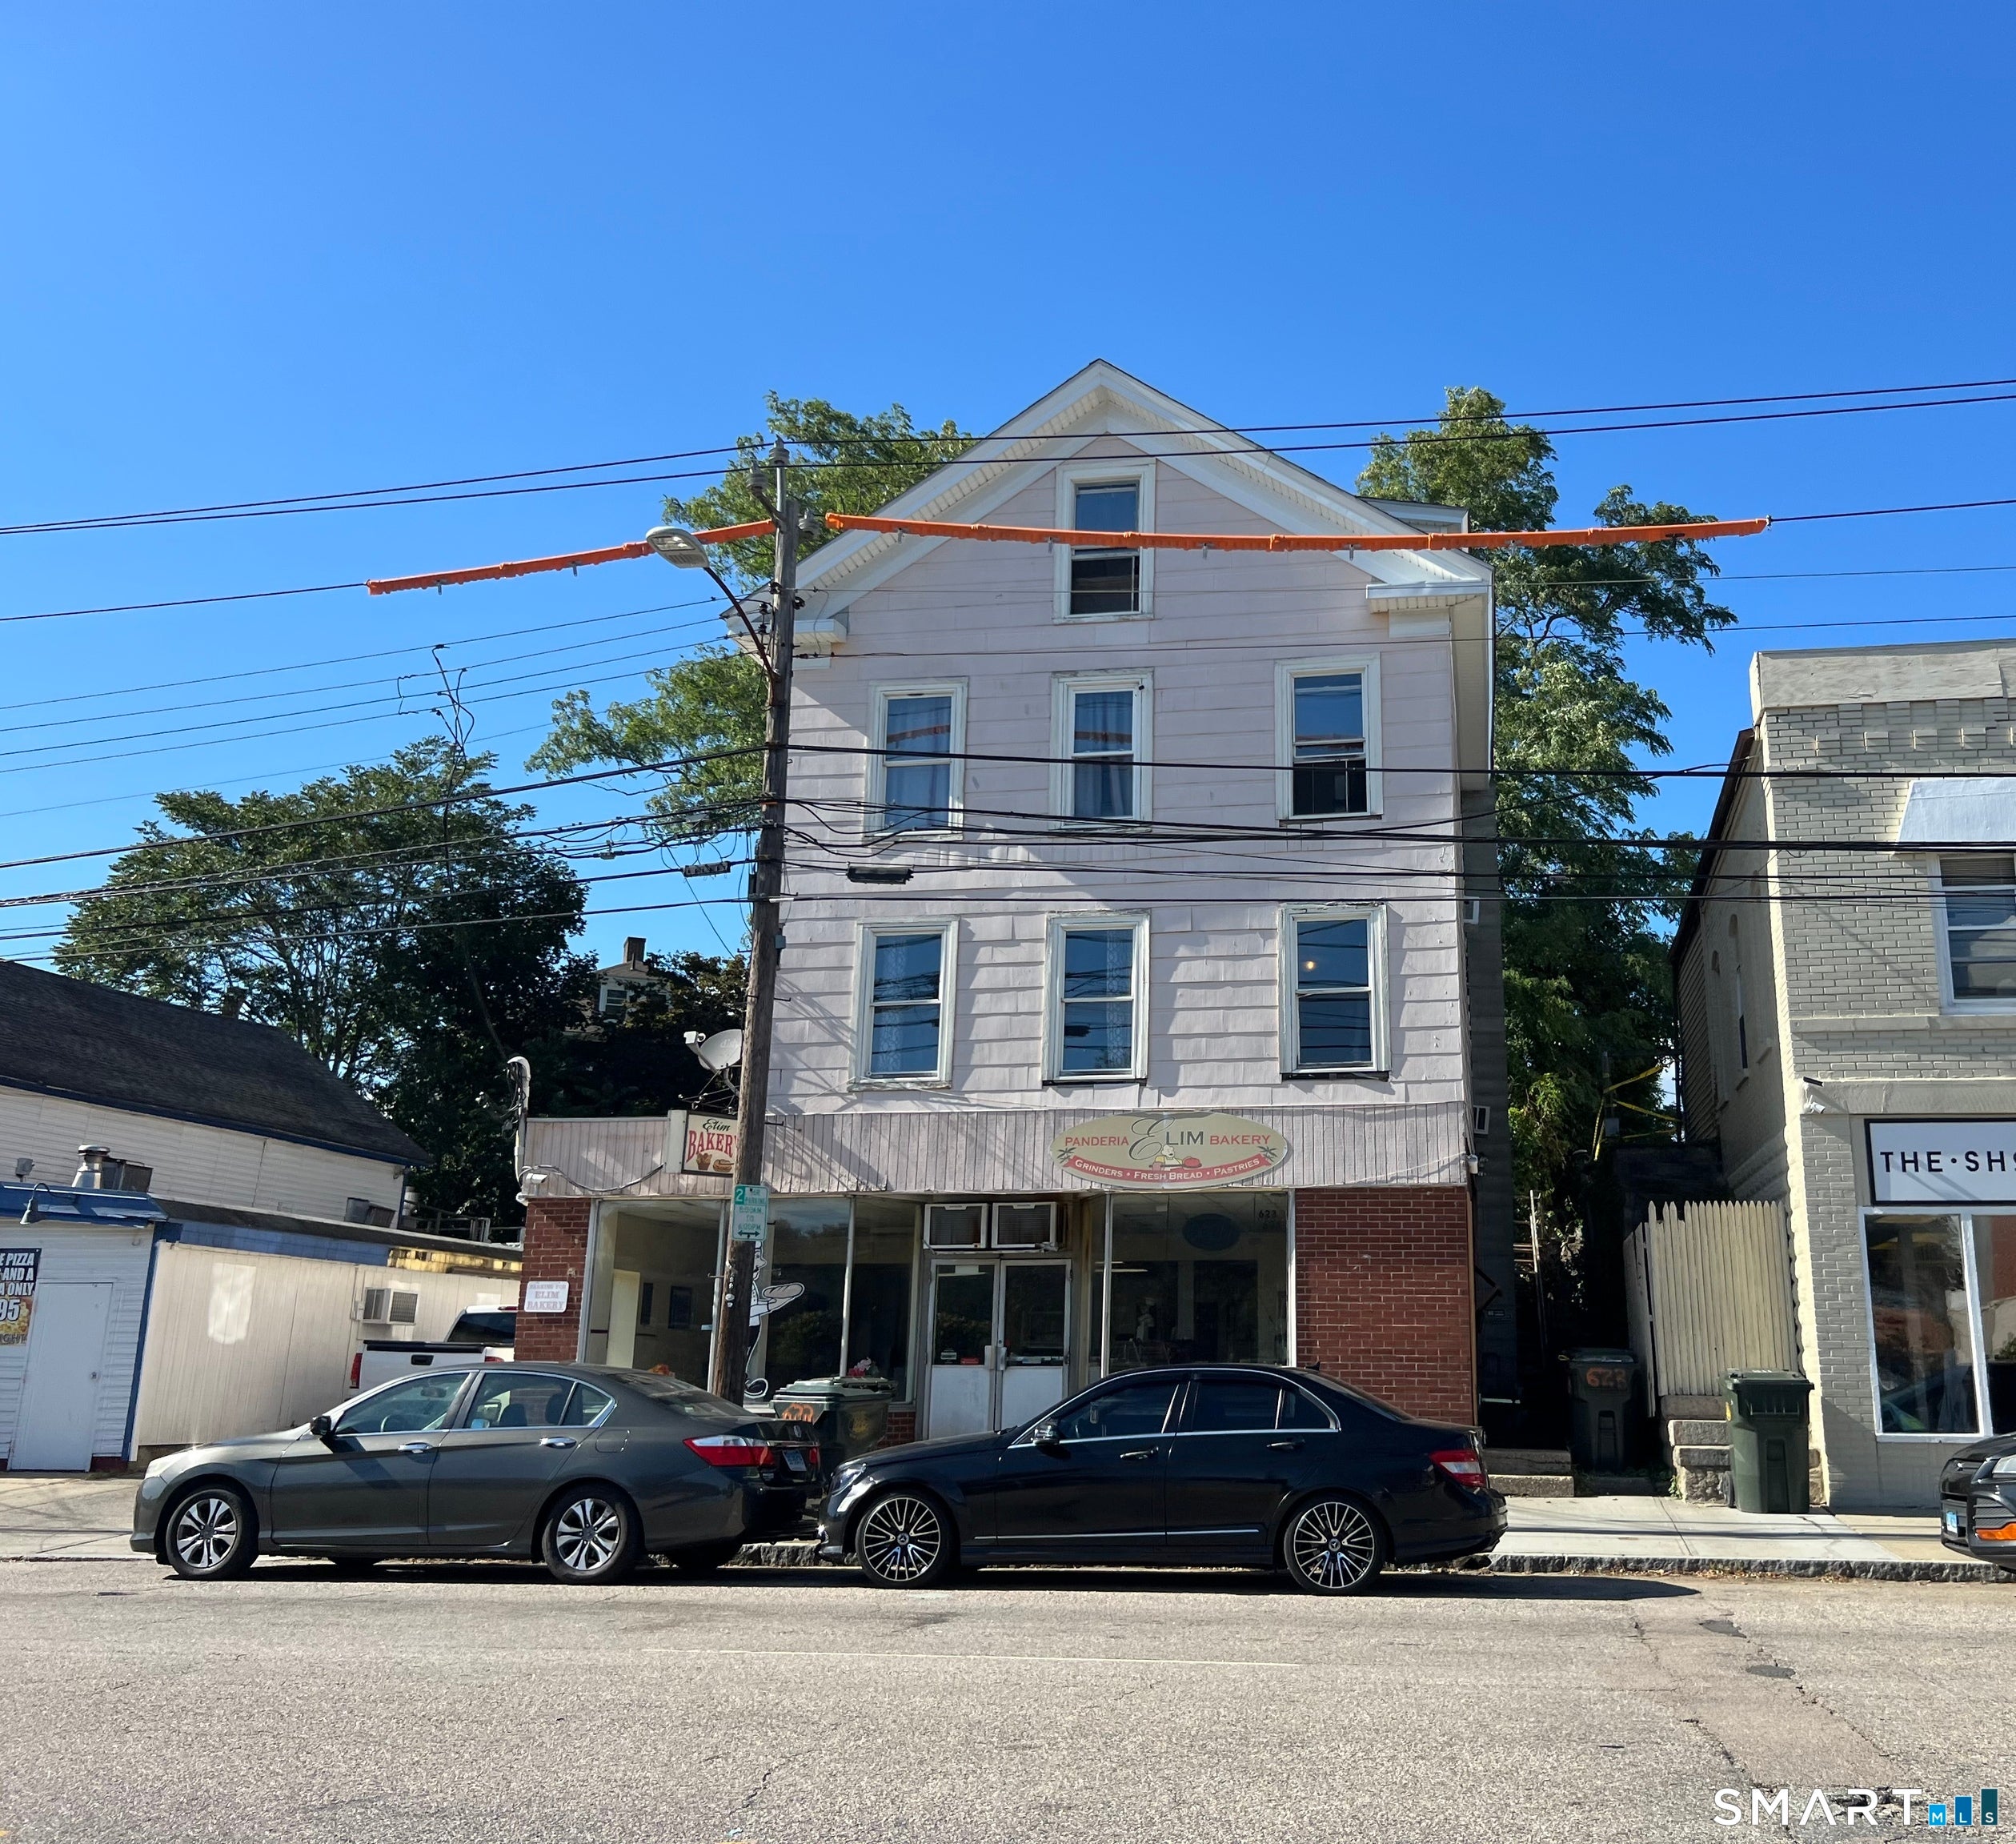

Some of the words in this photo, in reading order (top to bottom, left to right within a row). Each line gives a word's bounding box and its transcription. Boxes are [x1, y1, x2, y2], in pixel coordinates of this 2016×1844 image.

[703, 1118, 731, 1132] Elim
[1064, 1136, 1129, 1147] PANDERIA
[1209, 1134, 1271, 1145] BAKERY
[1880, 1151, 1943, 1173] THE
[1965, 1151, 2016, 1173] SH
[1074, 1159, 1124, 1178] GRINDERS
[1134, 1171, 1166, 1181] FRESH
[1169, 1171, 1203, 1181] BREAD
[1213, 1158, 1261, 1177] PASTRIES
[735, 1189, 743, 1202] 2
[6, 1253, 34, 1266] PIZZA
[2, 1268, 25, 1281] AND
[26, 1268, 34, 1281] A
[7, 1282, 34, 1296] ONLY
[535, 1291, 560, 1299] ELIM
[527, 1301, 565, 1309] BAKERY
